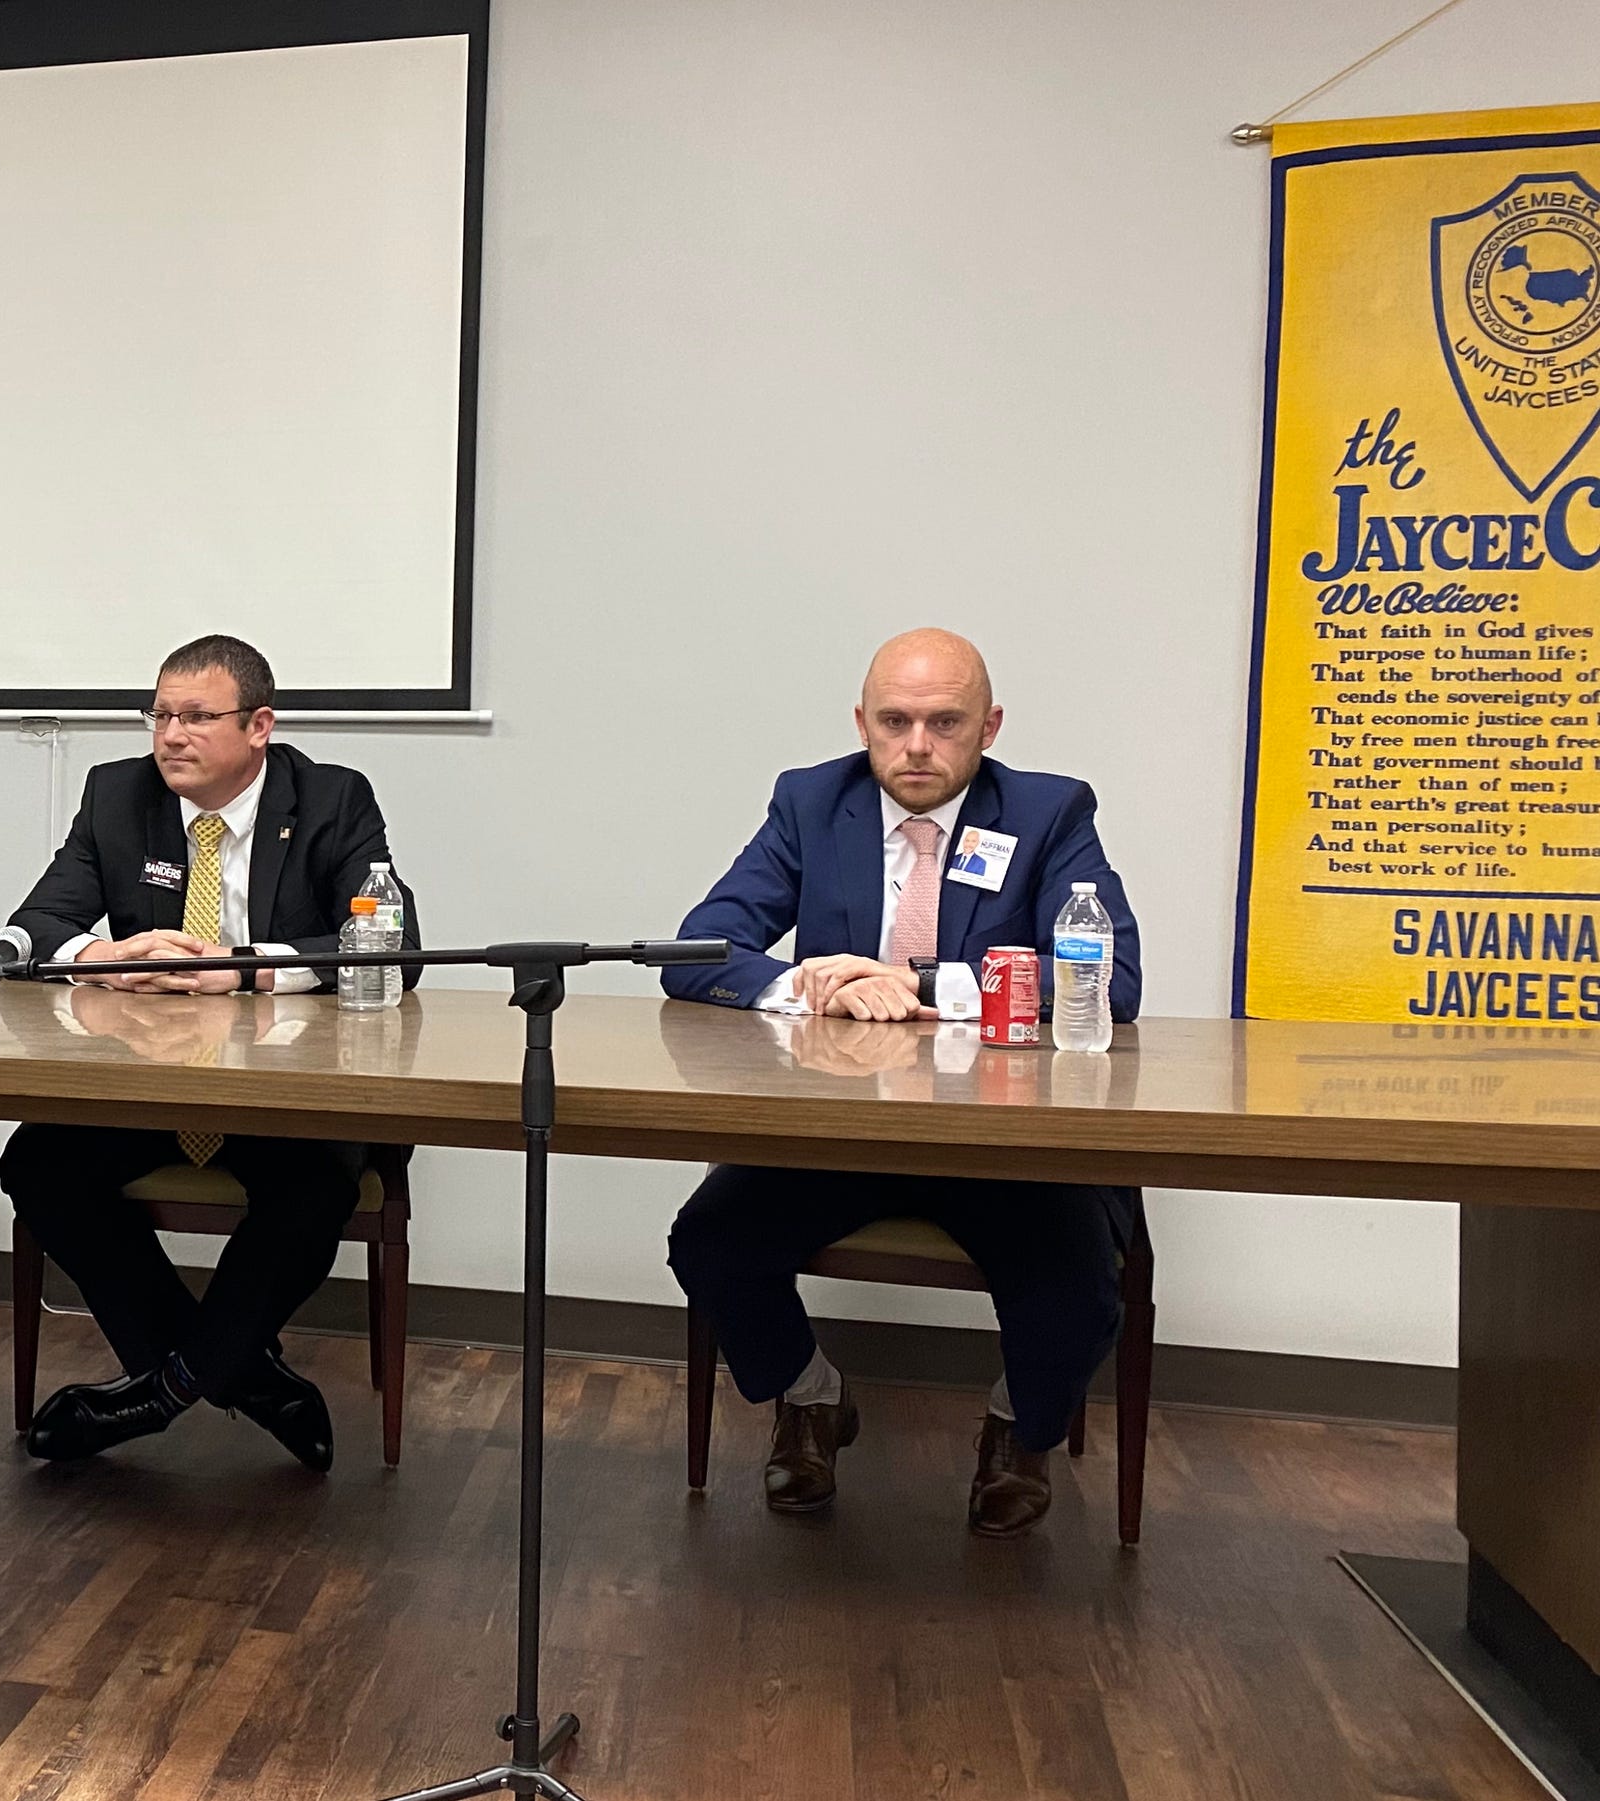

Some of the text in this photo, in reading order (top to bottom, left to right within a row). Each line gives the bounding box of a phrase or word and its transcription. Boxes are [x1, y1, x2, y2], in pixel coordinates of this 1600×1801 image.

[1493, 192, 1600, 220] MEMBER
[1473, 217, 1538, 289] RECOGNIZED
[1473, 295, 1529, 346] OFFICIALLY
[1455, 336, 1538, 386] UNITED
[1523, 356, 1557, 369] THE
[1484, 380, 1599, 409] JAYCEES
[1317, 581, 1519, 616] We Believe:
[1314, 620, 1594, 641] That faith in God gives
[1339, 649, 1425, 664] purpose
[1434, 647, 1456, 660] to
[1460, 645, 1532, 660] human
[1311, 663, 1600, 682] That the brotherhood of
[1337, 689, 1600, 707] cends the sovereignty of
[1311, 706, 1365, 725] That
[1371, 712, 1469, 726] economic
[1475, 711, 1544, 727] justice
[1550, 715, 1589, 727] can
[1330, 732, 1600, 751] by free men through free
[1309, 749, 1363, 767] That
[1373, 755, 1500, 770] government
[1509, 756, 1583, 771] should
[1333, 775, 1402, 790] rather
[1418, 776, 1468, 791] than
[1479, 777, 1501, 792] of
[1308, 791, 1362, 810] That
[1370, 797, 1446, 811] earth's
[1454, 799, 1510, 815] great
[1331, 820, 1378, 831] man
[980, 840, 1011, 854] HUFFMAN
[1306, 833, 1354, 853] And
[1363, 839, 1408, 854] that
[1419, 842, 1497, 856] service
[1506, 843, 1528, 856] to
[144, 862, 182, 880] SANDERS
[1328, 858, 1517, 877] best work of life.
[1393, 908, 1600, 964] SAVANNA
[1408, 970, 1600, 1021] JAYCEES
